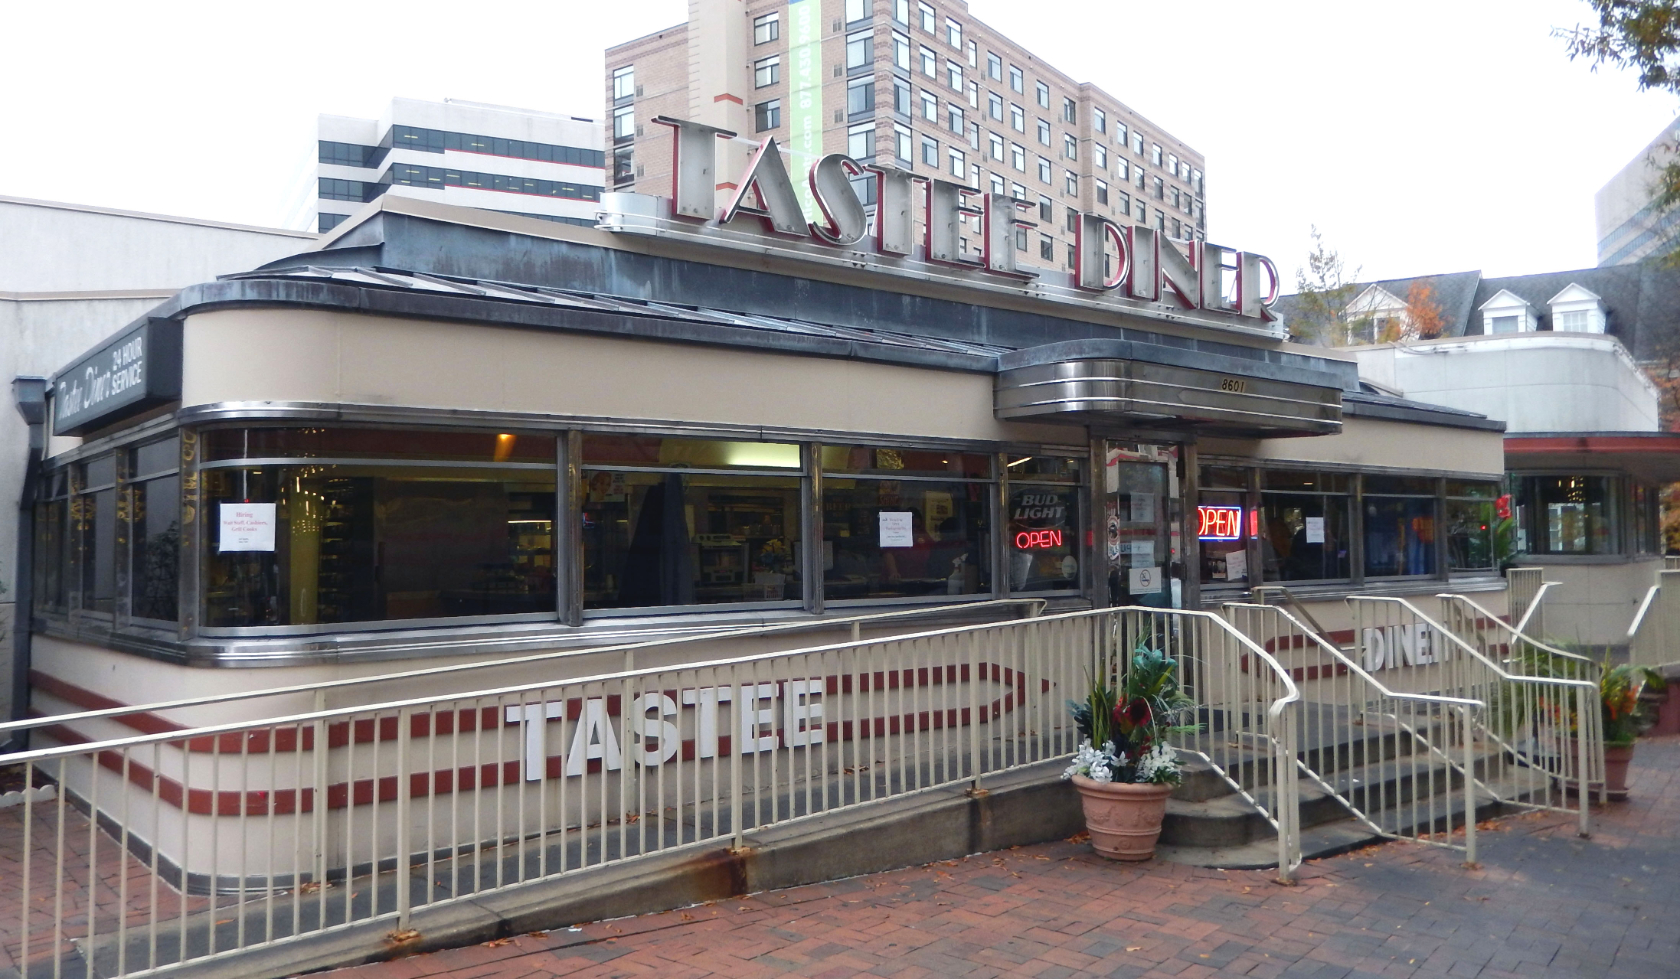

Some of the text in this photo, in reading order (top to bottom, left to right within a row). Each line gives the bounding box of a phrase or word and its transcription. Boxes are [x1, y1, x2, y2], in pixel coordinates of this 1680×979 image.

[651, 115, 1280, 322] TASTEE DINER
[123, 337, 142, 365] HOUR
[112, 361, 142, 395] SERVICE
[1221, 379, 1245, 392] 8601
[1021, 494, 1058, 506] BUD
[1013, 507, 1065, 520] LIGHT
[1016, 529, 1062, 549] OPEN
[505, 680, 823, 781] TASTEE
